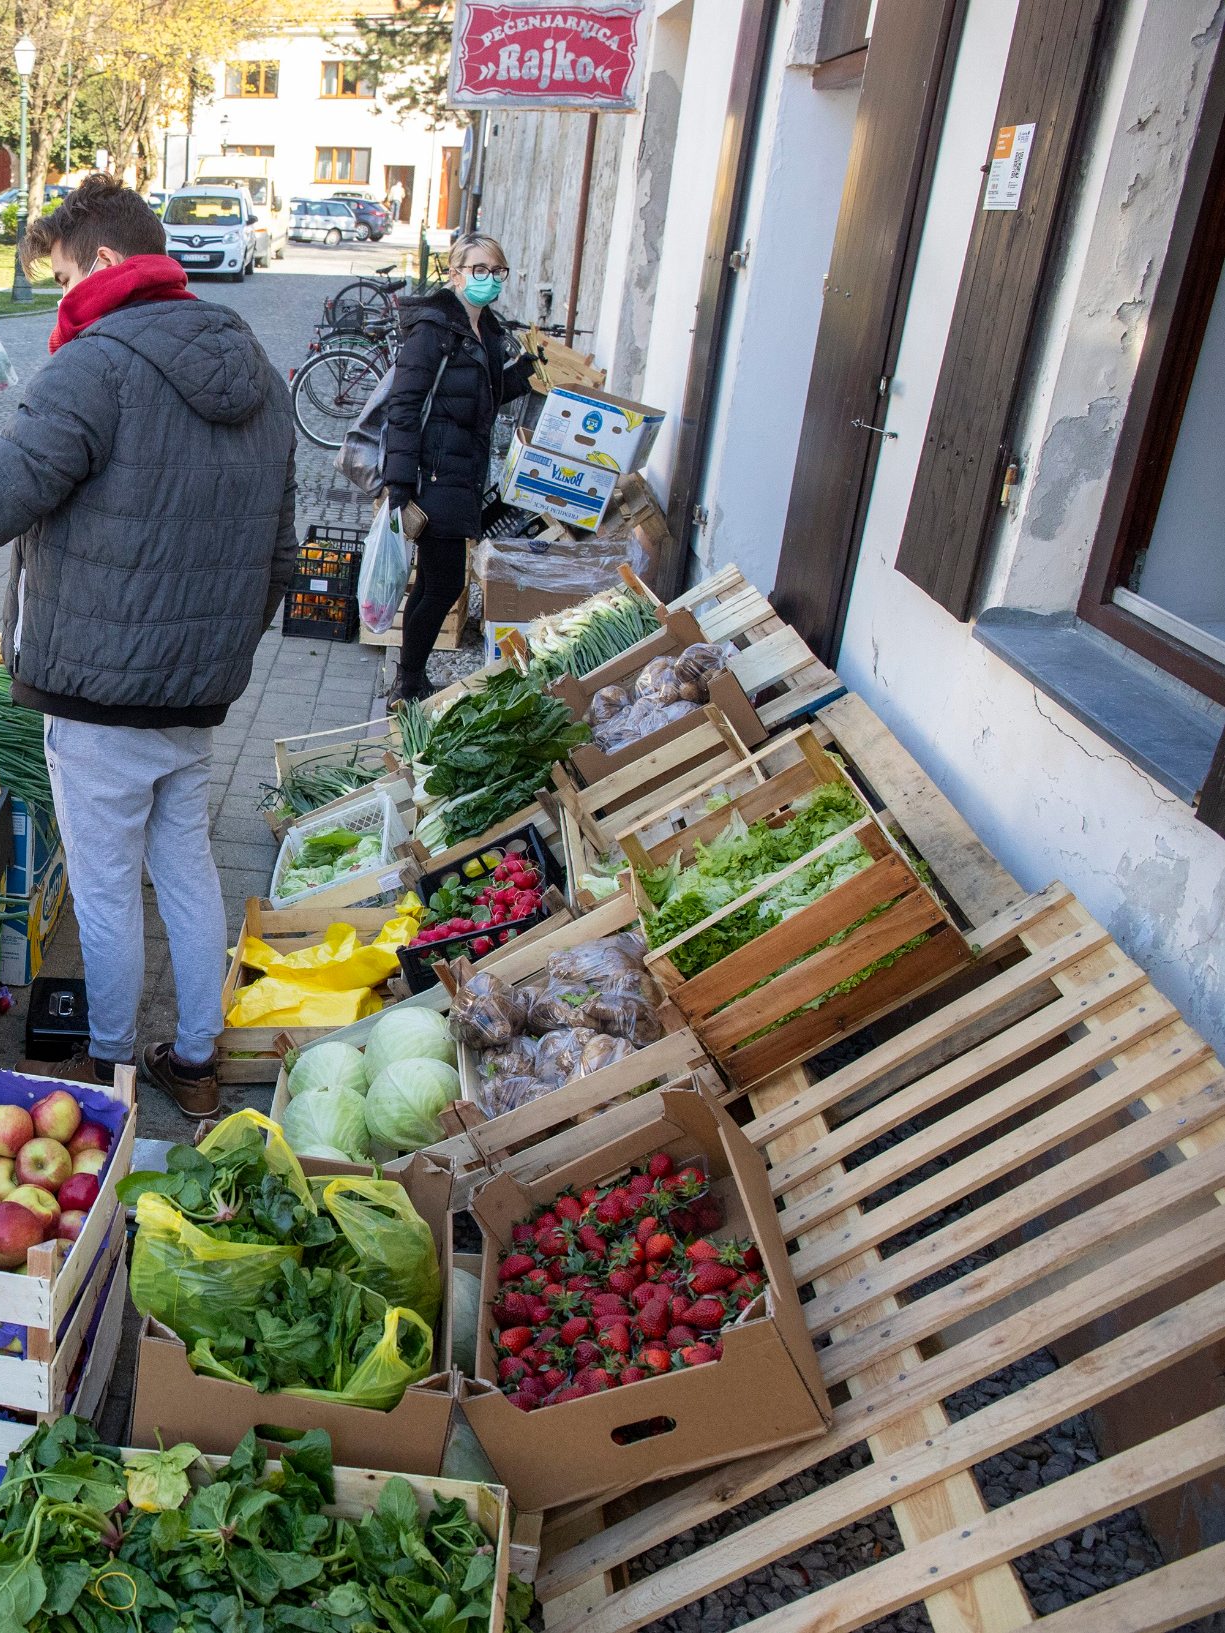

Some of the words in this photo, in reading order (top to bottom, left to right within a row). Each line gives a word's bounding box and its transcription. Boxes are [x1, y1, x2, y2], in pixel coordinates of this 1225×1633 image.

[480, 14, 621, 50] PEČENJARNICA
[552, 464, 585, 487] BONITA
[534, 501, 550, 511] PACK
[551, 507, 579, 520] PREMIUM
